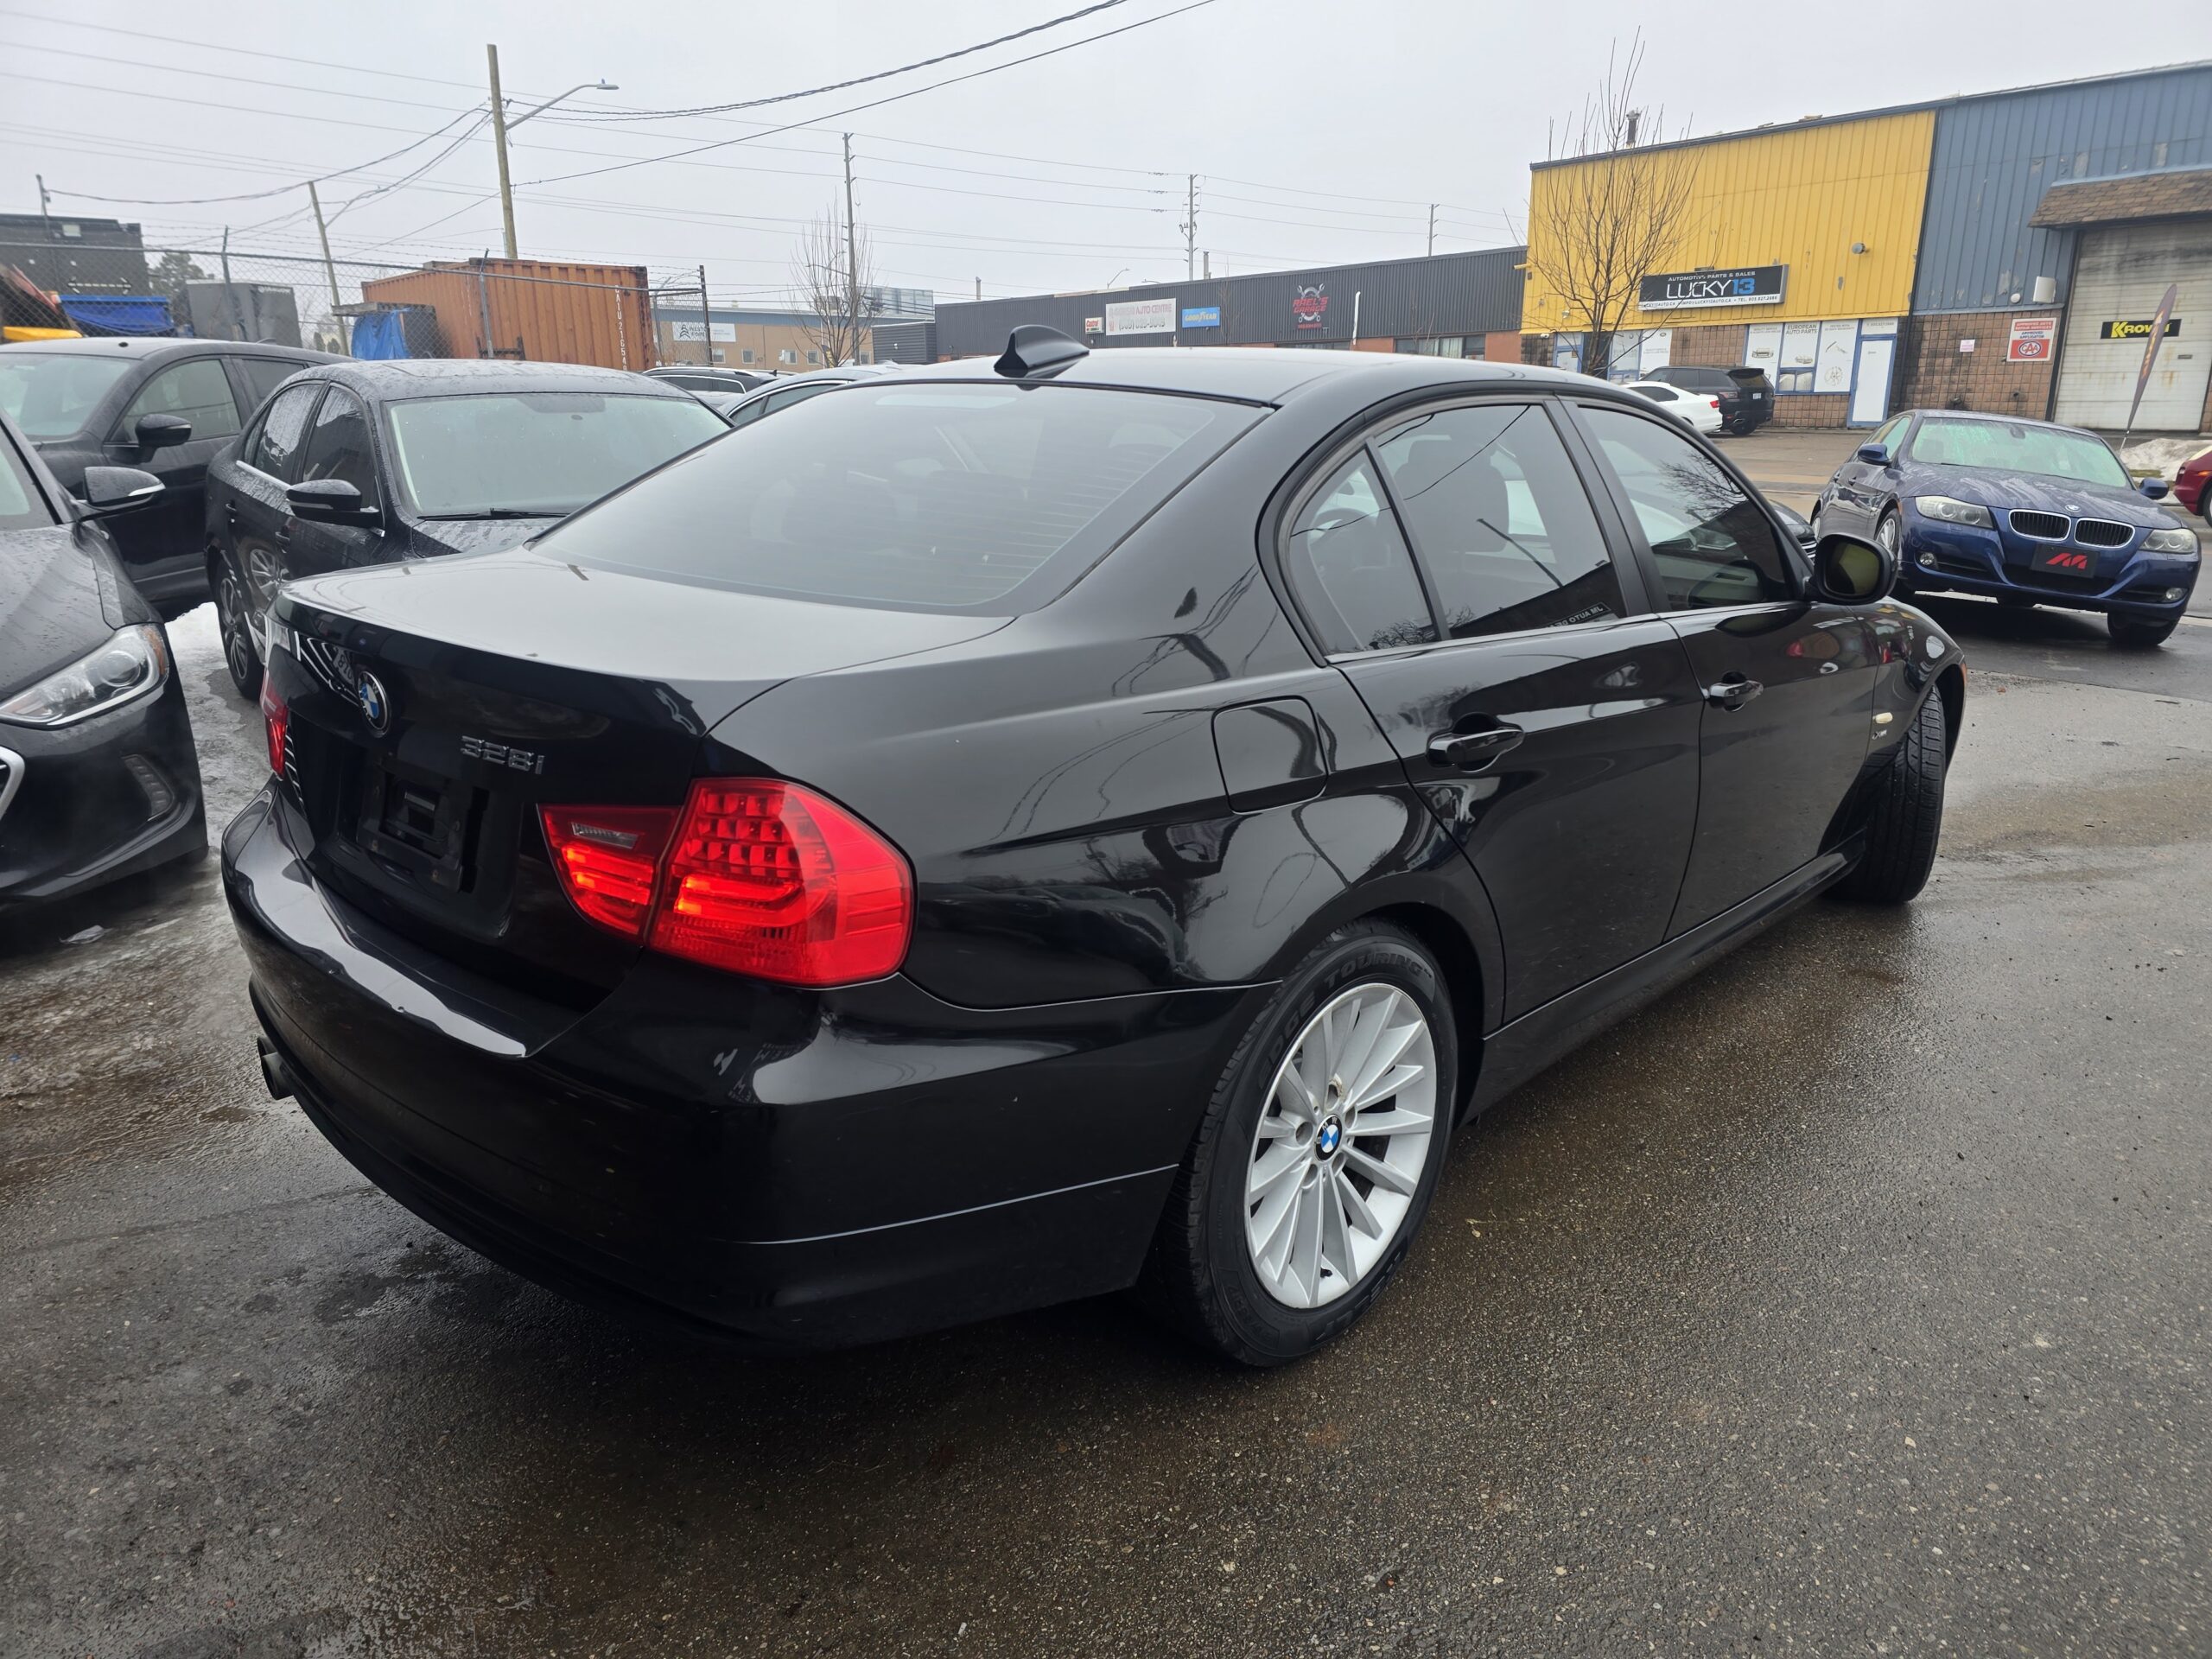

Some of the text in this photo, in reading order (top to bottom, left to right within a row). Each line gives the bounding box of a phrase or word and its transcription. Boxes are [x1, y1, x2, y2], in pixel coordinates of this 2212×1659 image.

[2021, 343, 2038, 354] CAA
[459, 734, 545, 775] 328i
[1324, 951, 1425, 989] TOURING
